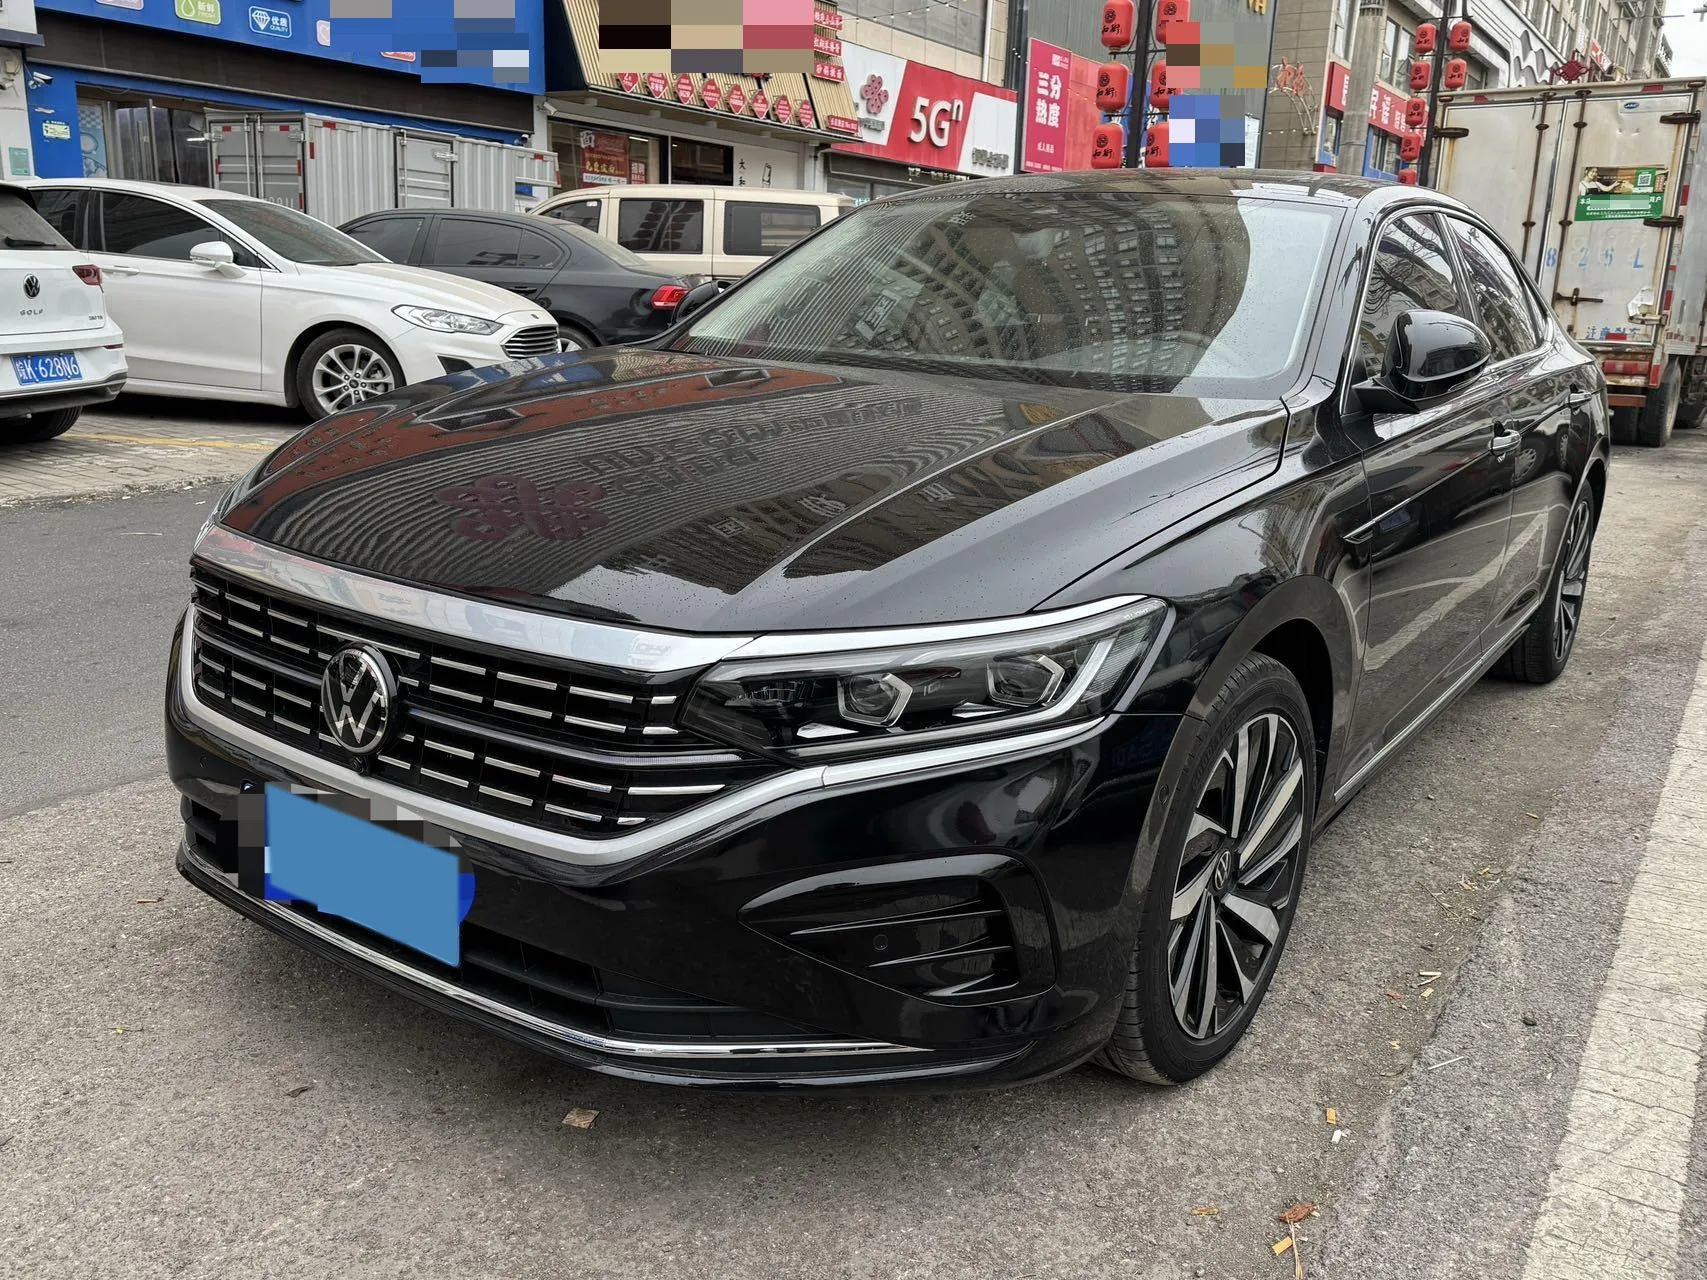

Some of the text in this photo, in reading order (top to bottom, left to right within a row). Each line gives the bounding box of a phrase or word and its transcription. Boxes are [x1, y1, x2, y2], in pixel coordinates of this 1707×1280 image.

[271, 16, 288, 27] 优质
[1036, 71, 1062, 100] 三分
[1035, 98, 1061, 128] 热度
[20, 308, 44, 316] GOLF
